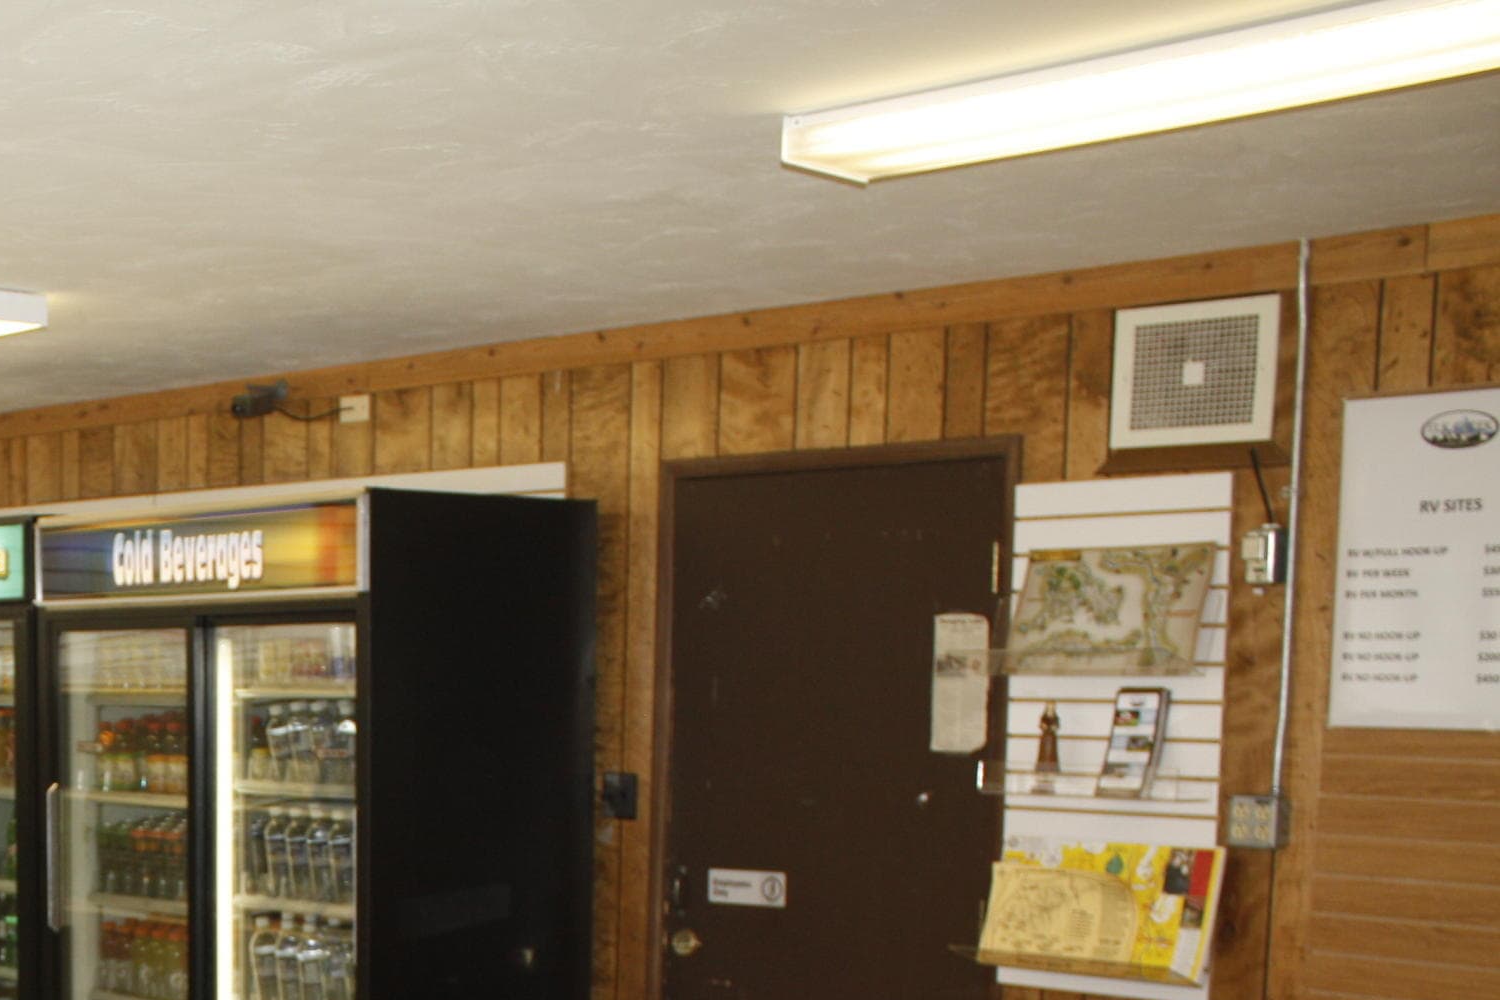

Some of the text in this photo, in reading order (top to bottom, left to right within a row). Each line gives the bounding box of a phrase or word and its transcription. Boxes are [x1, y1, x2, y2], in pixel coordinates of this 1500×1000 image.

[1419, 498, 1483, 513] RV SITES
[112, 529, 265, 590] Cold Beverages
